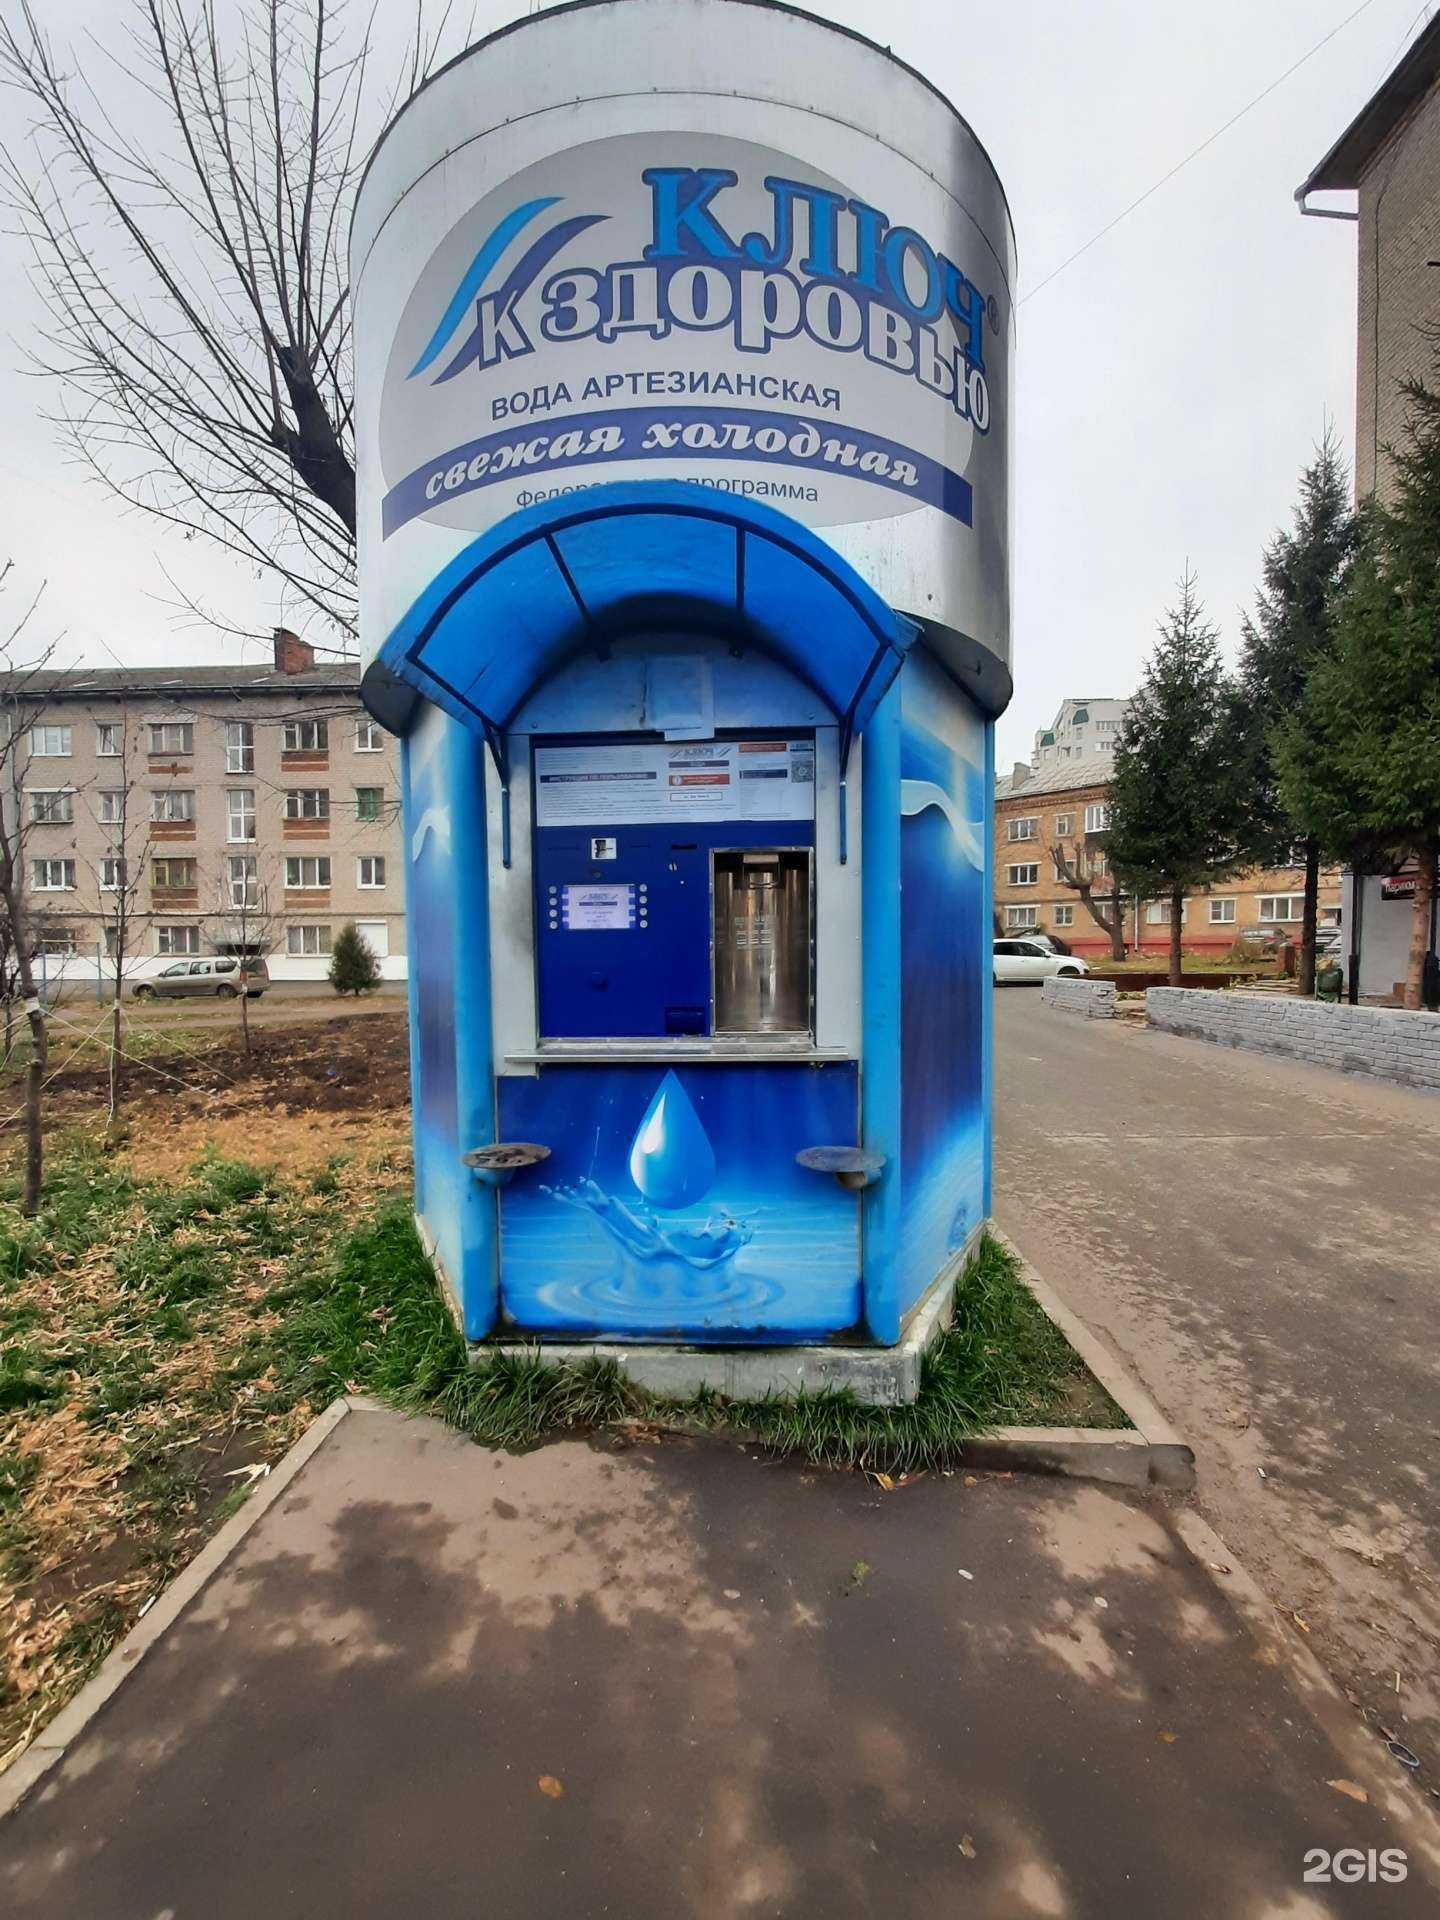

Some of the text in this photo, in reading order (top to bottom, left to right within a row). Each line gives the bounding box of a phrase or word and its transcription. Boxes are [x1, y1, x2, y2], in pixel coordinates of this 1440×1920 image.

[642, 167, 986, 373] КЛЮЧ
[492, 370, 841, 421] ВОДА АРТЕЗИАНСКАЯ
[540, 260, 990, 435] здоровью
[425, 421, 919, 500] свежая холодная
